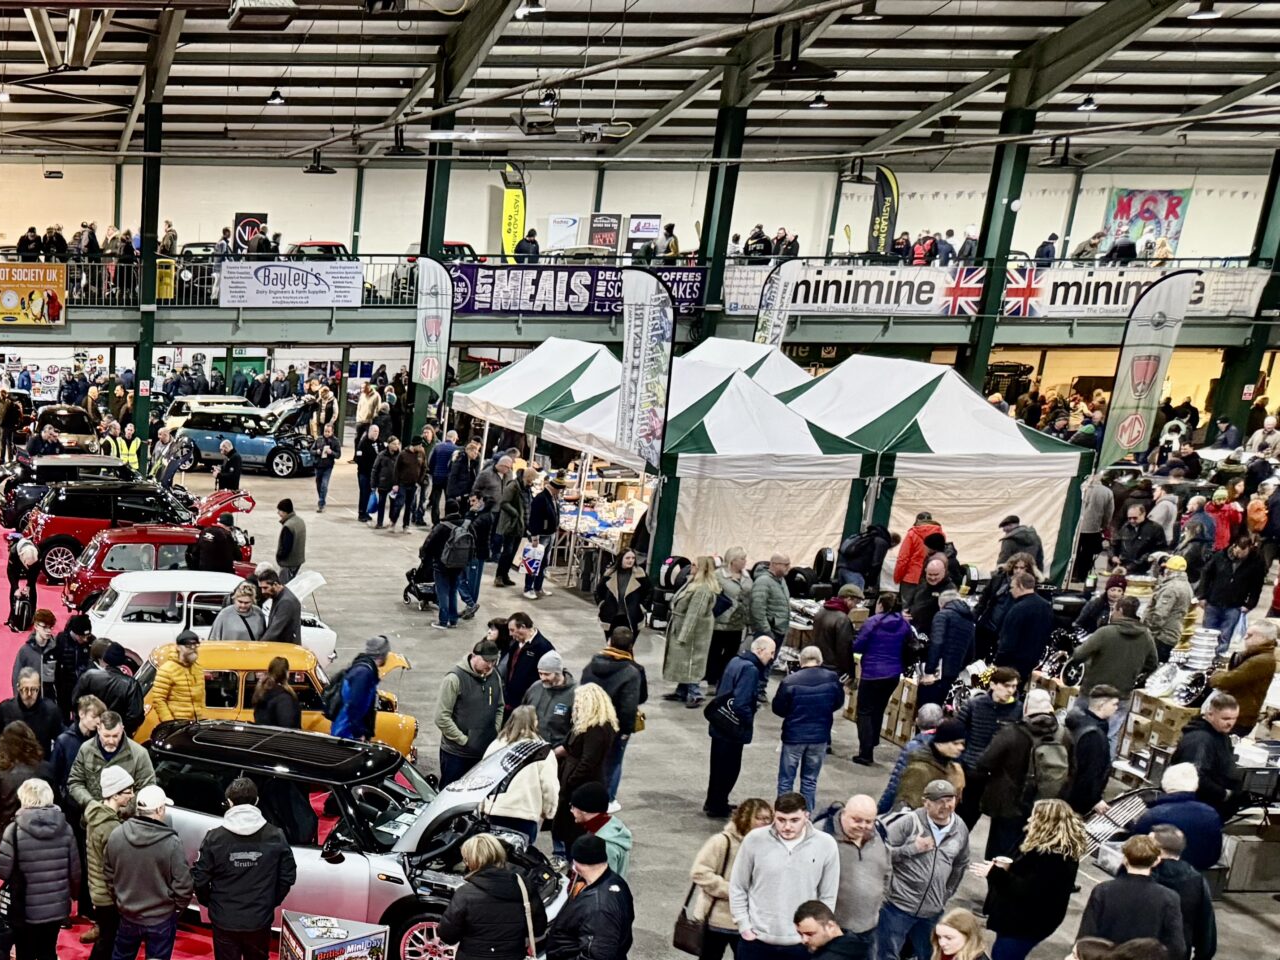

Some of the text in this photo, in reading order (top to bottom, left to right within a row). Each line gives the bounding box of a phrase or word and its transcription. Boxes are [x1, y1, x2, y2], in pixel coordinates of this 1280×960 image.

[880, 197, 891, 233] FASTLAD
[12, 268, 45, 281] SOCIETY
[47, 269, 58, 281] UK
[263, 267, 321, 289] Bayley's
[474, 268, 493, 310] TASTY
[596, 281, 606, 297] AND
[670, 281, 701, 299] AKES
[1050, 270, 1205, 305] minime
[492, 270, 592, 312] MEALS
[1119, 417, 1143, 448] MG
[317, 938, 384, 960] British Mini Day
